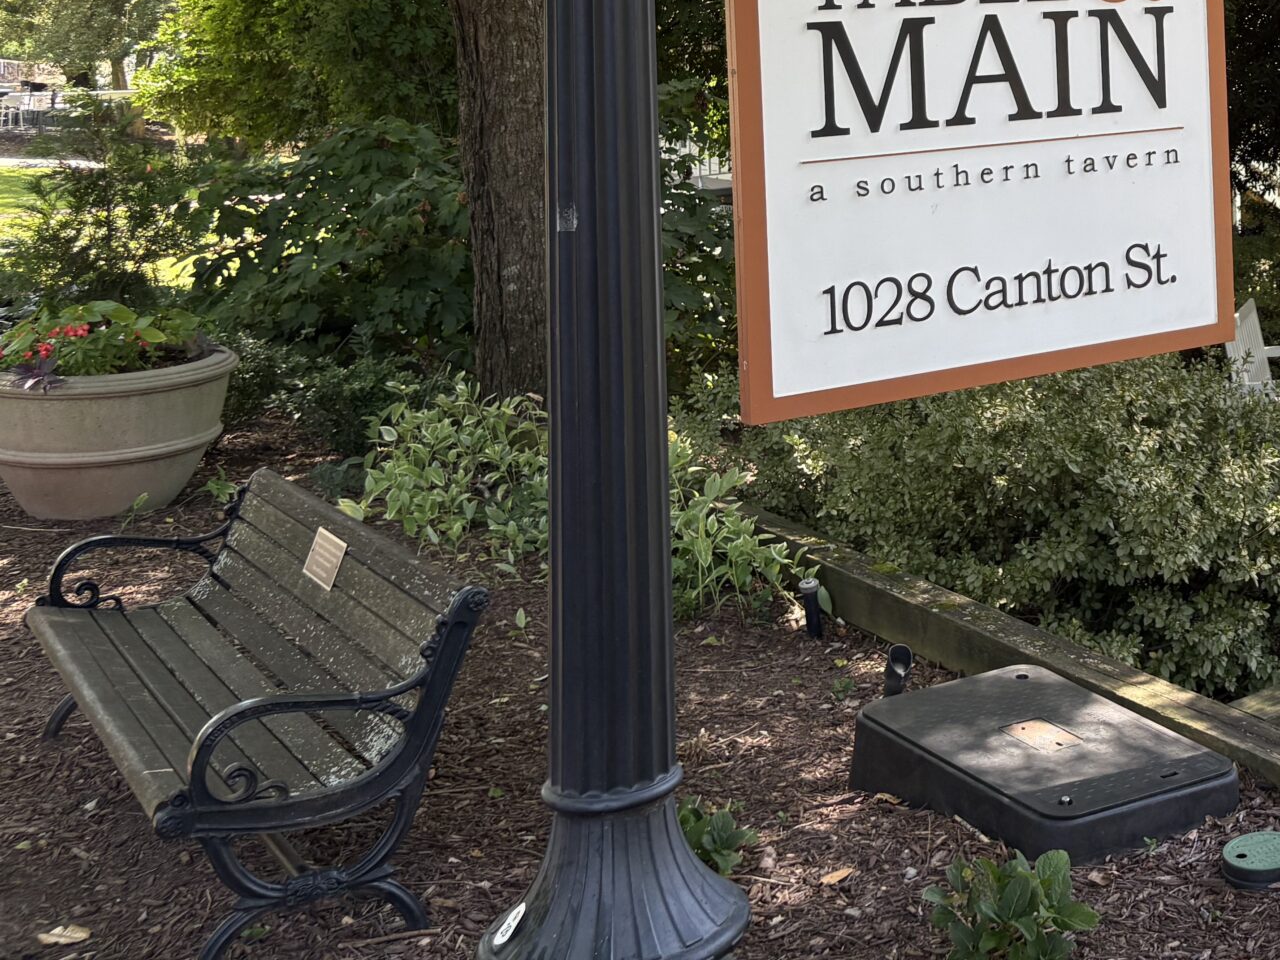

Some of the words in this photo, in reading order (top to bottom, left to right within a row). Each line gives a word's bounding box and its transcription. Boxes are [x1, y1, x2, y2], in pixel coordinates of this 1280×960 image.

[806, 6, 1174, 139] MAIN
[809, 184, 827, 202] a
[855, 161, 1042, 198] southern
[1064, 146, 1181, 176] tavern
[822, 271, 936, 336] 1028
[946, 258, 1115, 316] Canton
[1125, 242, 1179, 290] St.
